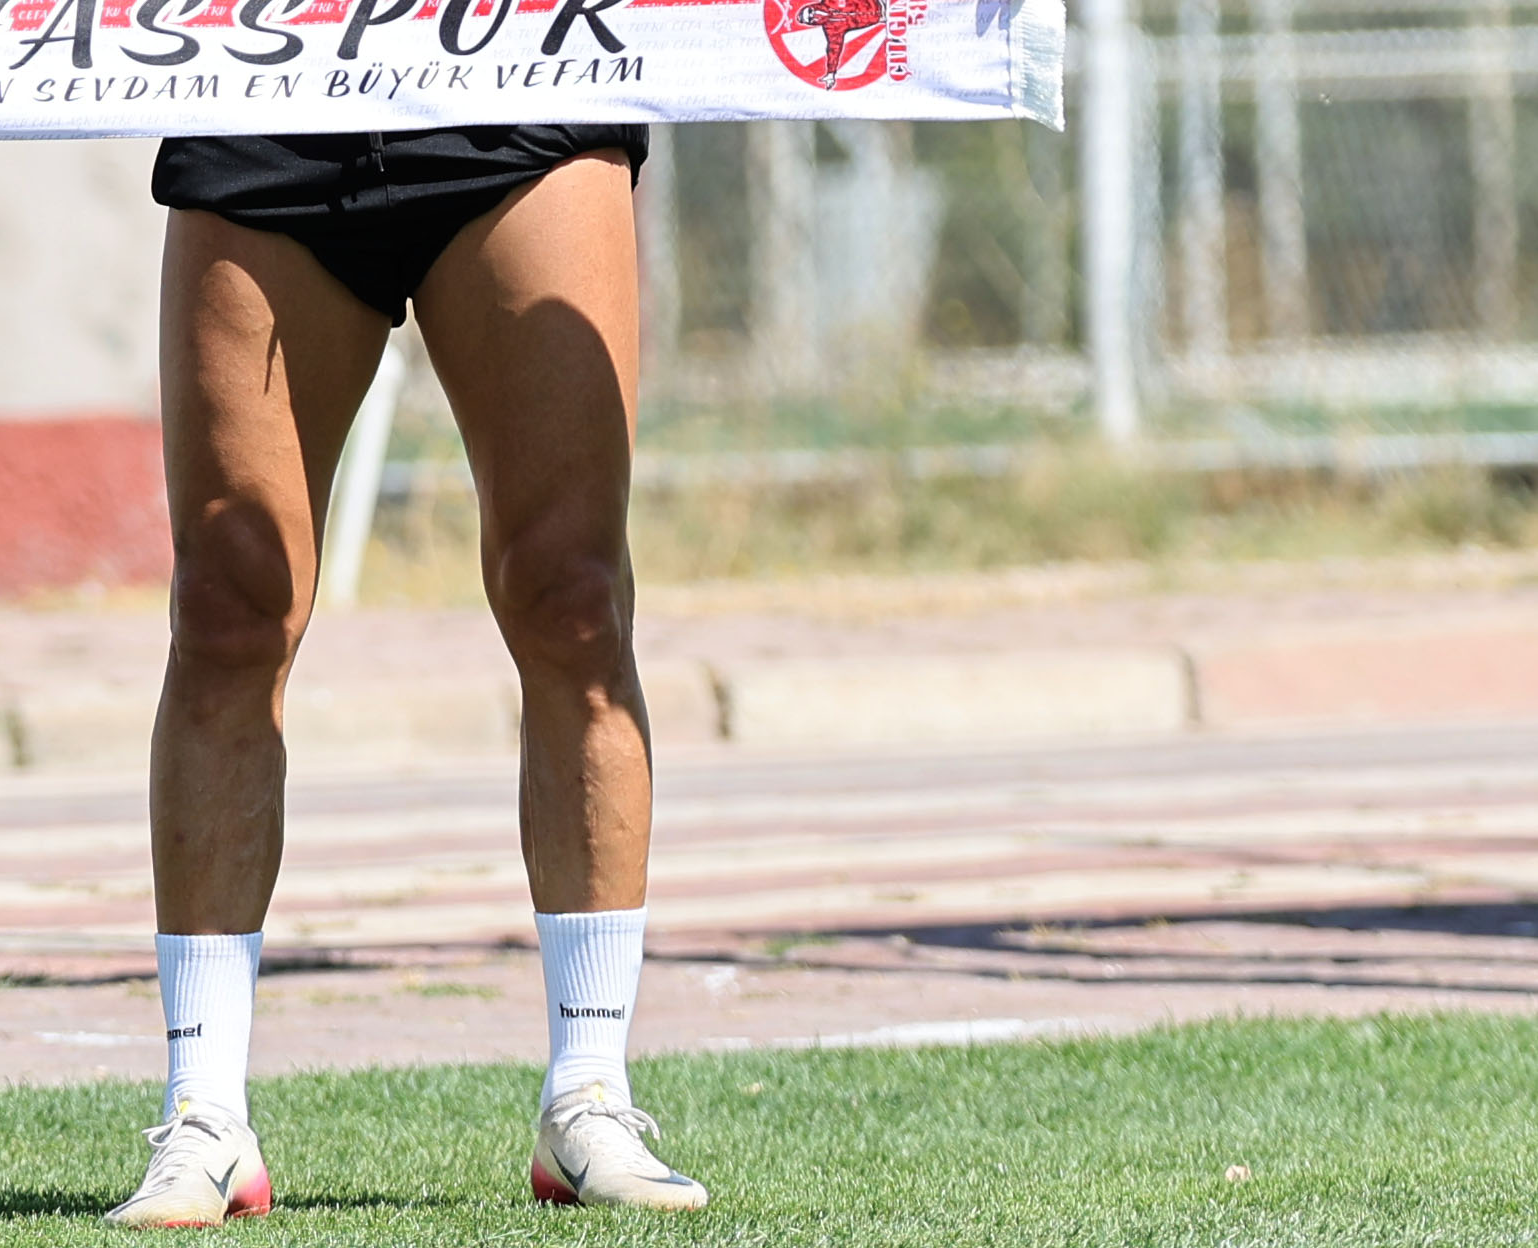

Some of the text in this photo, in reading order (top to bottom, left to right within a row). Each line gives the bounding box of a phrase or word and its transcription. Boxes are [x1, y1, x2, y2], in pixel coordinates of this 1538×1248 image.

[33, 74, 219, 102] SEVDAM
[244, 72, 304, 99] EN
[321, 61, 474, 100] BÜYÜK
[496, 55, 644, 89] VEFAM
[559, 1002, 625, 1021] hummel
